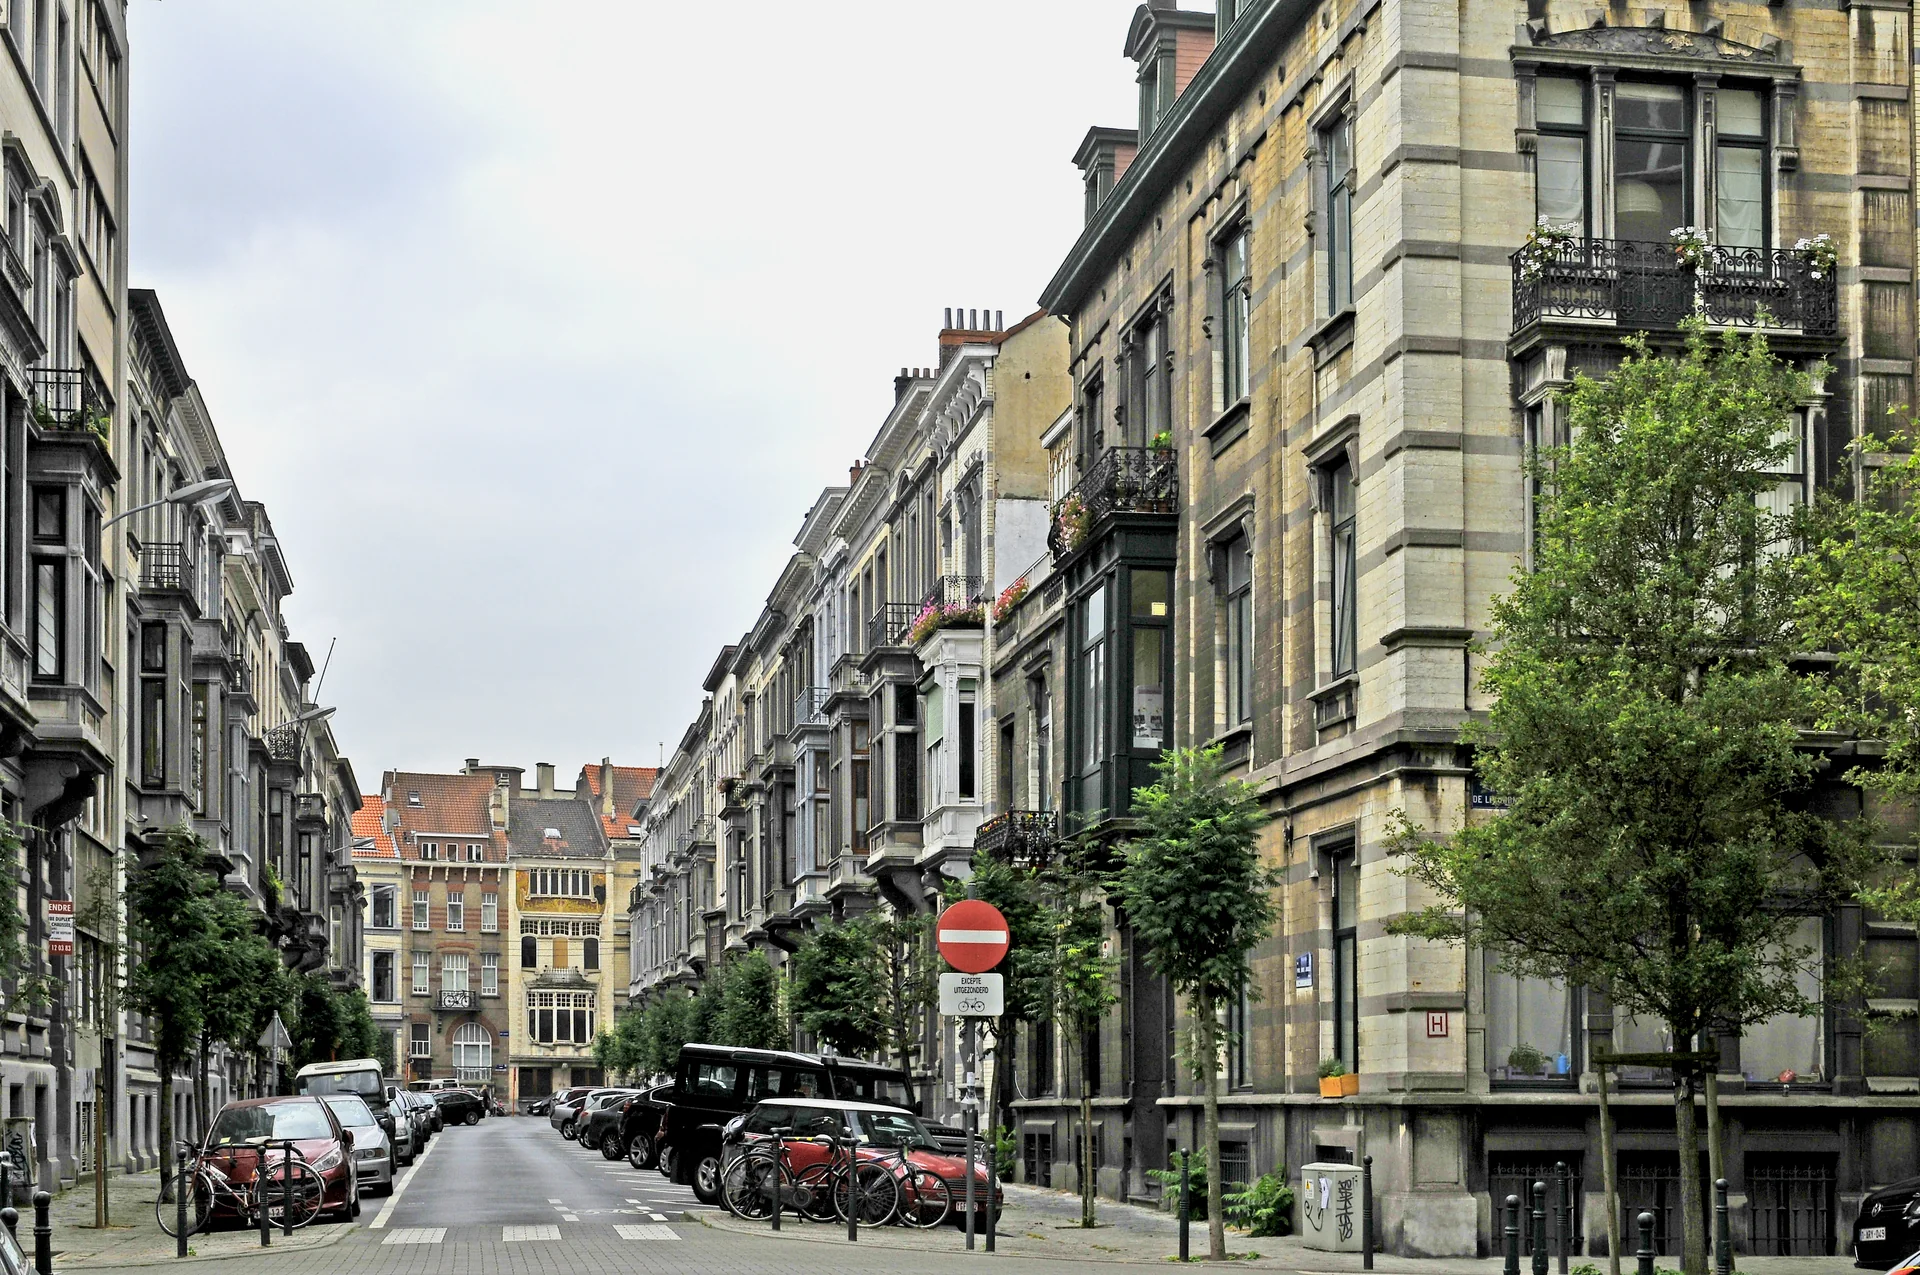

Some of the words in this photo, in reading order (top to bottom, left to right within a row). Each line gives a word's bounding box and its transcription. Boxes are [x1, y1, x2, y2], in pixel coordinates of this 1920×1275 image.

[1472, 795, 1483, 804] DE
[953, 986, 989, 994] UITGEZONDERD
[1431, 1015, 1443, 1032] H
